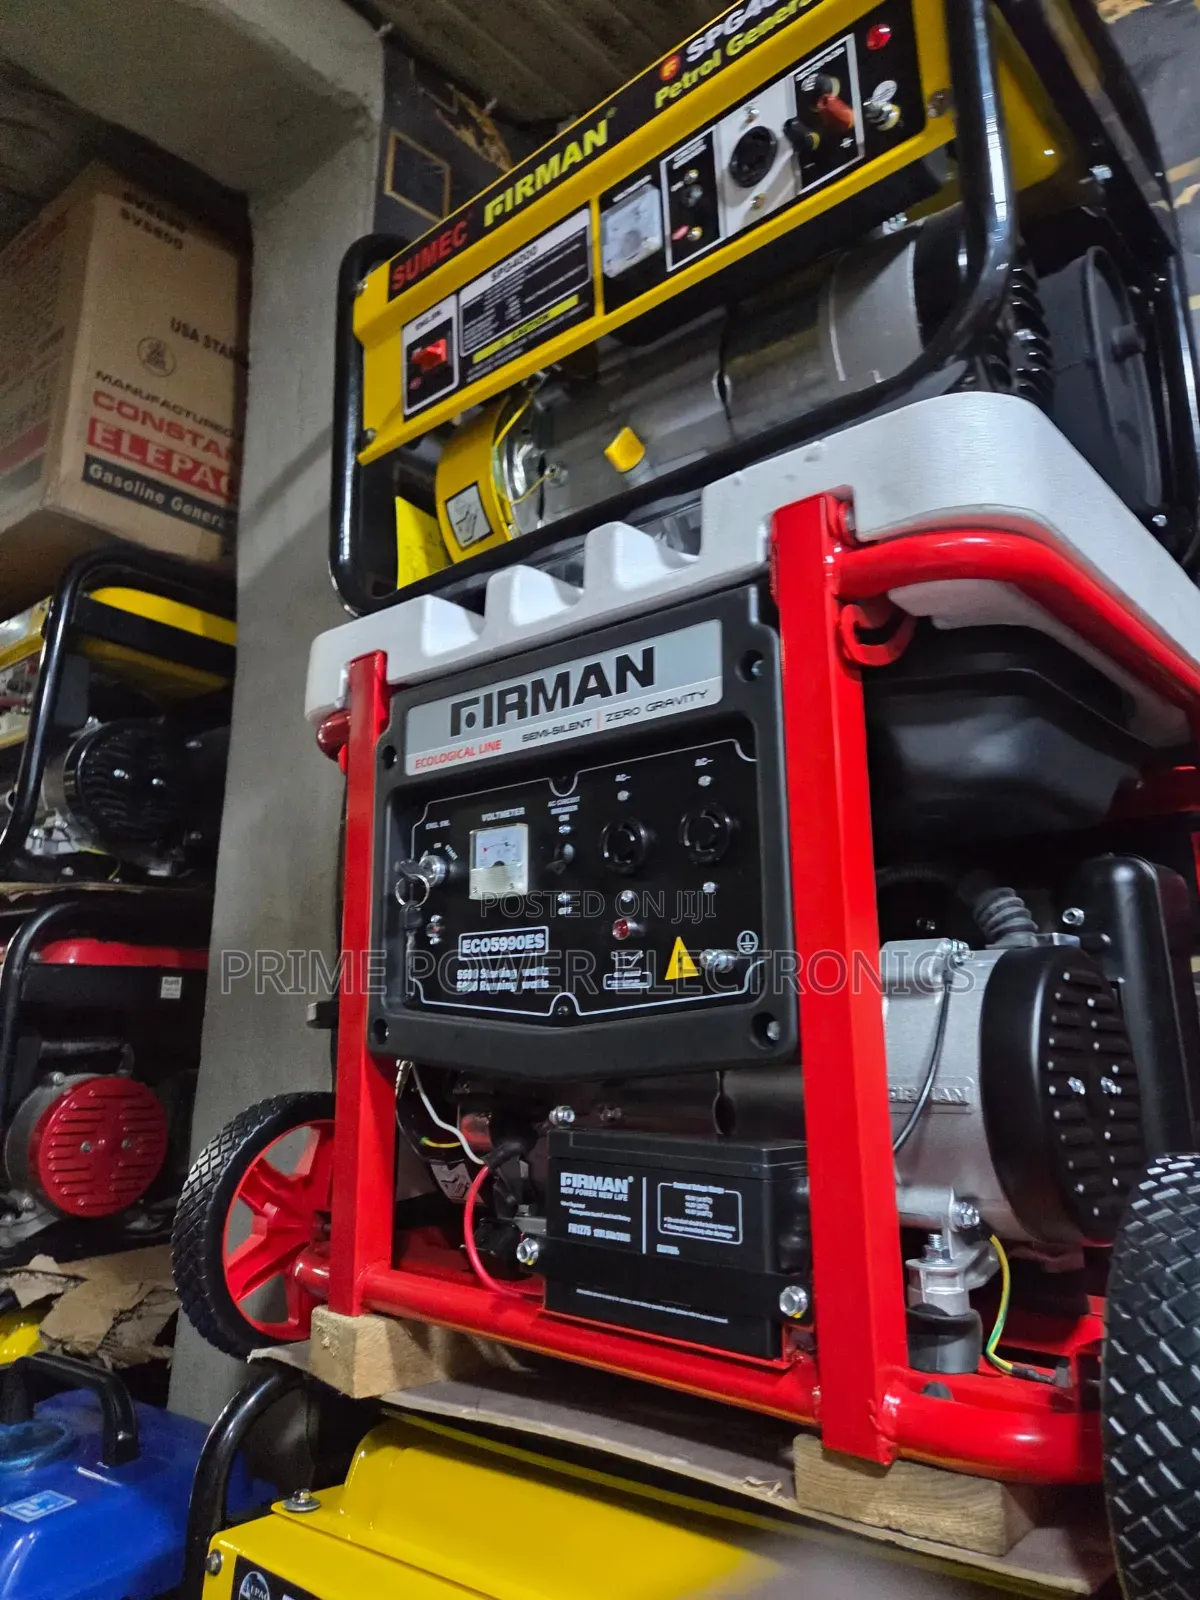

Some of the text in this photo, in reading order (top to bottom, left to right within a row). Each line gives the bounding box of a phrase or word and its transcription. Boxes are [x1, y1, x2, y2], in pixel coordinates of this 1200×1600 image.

[686, 0, 779, 62] SPG4
[655, 49, 722, 109] Petrol
[483, 118, 608, 228] FIRMAN
[392, 220, 469, 291] SUMEC
[491, 245, 538, 282] SPG4000
[171, 316, 200, 343] USA
[89, 463, 165, 505] Gasoline
[450, 645, 657, 738] FIRMAN
[415, 690, 709, 769] ECOLOGICAL LINE SEMI-SILENT ZERO GRAVITY
[481, 807, 525, 822] VOLTMETER
[461, 933, 545, 954] ECO5990ES
[480, 967, 517, 980] Starting
[521, 966, 549, 976] watts
[480, 980, 517, 992] Running
[521, 979, 549, 989] watts
[560, 1172, 629, 1194] FIRMAN
[614, 1193, 629, 1202] LIFE
